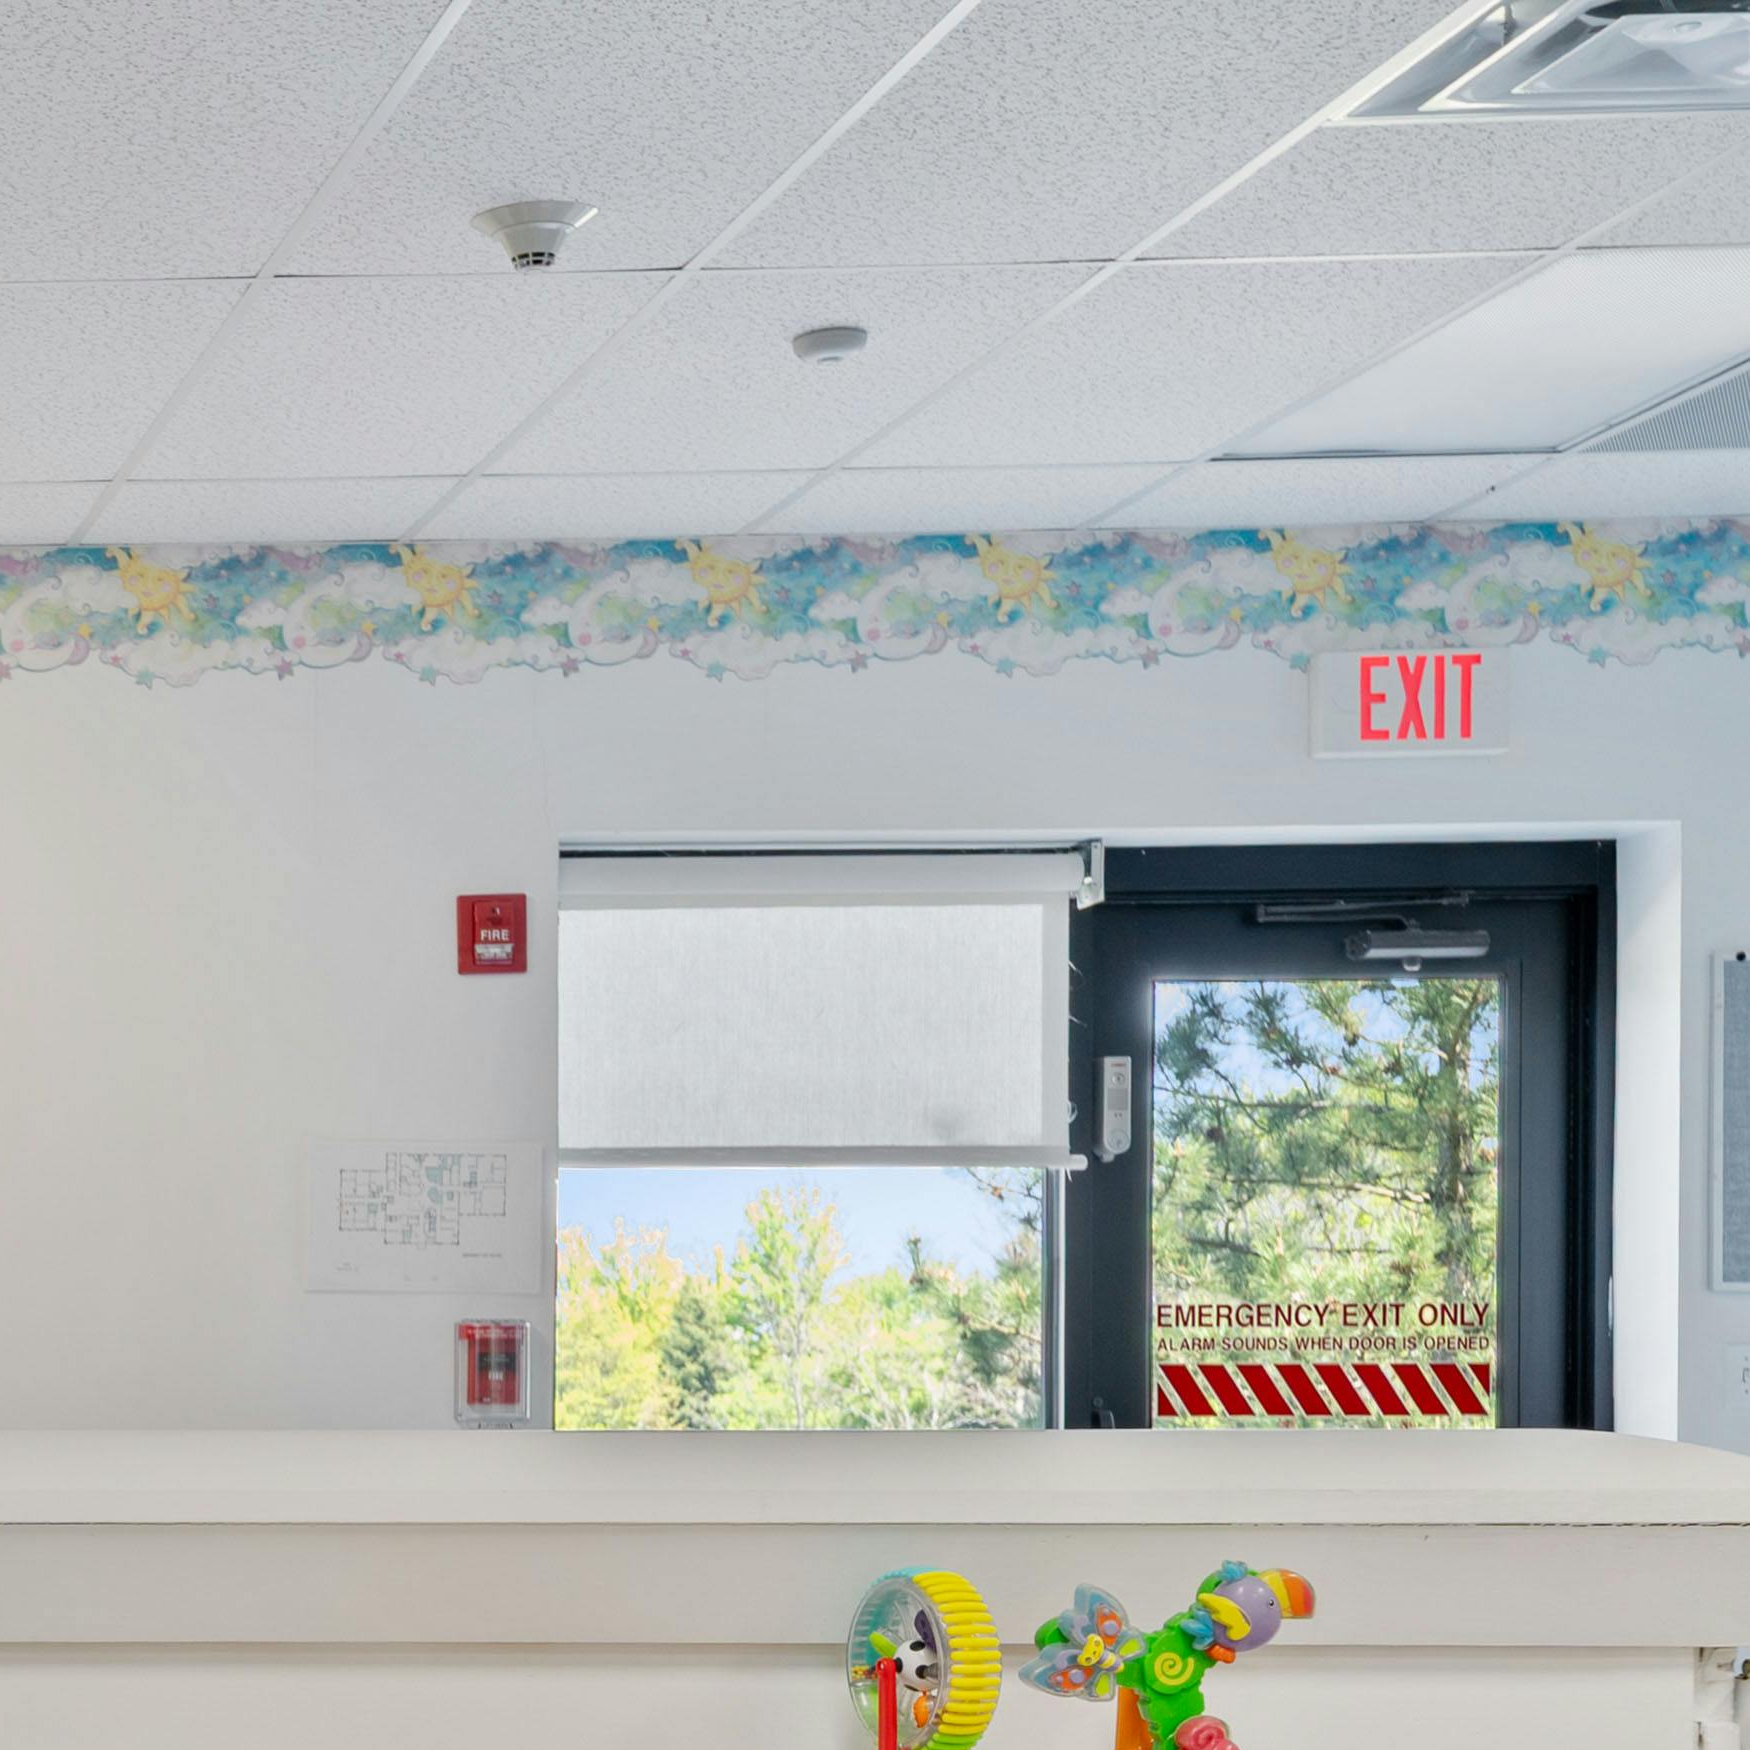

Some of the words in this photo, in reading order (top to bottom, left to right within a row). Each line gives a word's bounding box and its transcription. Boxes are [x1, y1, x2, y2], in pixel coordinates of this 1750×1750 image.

[1360, 654, 1482, 741] EXIT
[480, 929, 510, 941] FIRE
[1156, 1303, 1329, 1328] EMERGENCY
[1342, 1303, 1405, 1327] EXIT
[1418, 1302, 1489, 1327] ONLY
[1157, 1337, 1215, 1352] ALARM
[1221, 1337, 1288, 1351] SOUNDS
[1295, 1337, 1343, 1351] WHEN
[1348, 1336, 1396, 1350] DOOR
[1402, 1336, 1417, 1350] IS
[1424, 1336, 1489, 1350] OPENED
